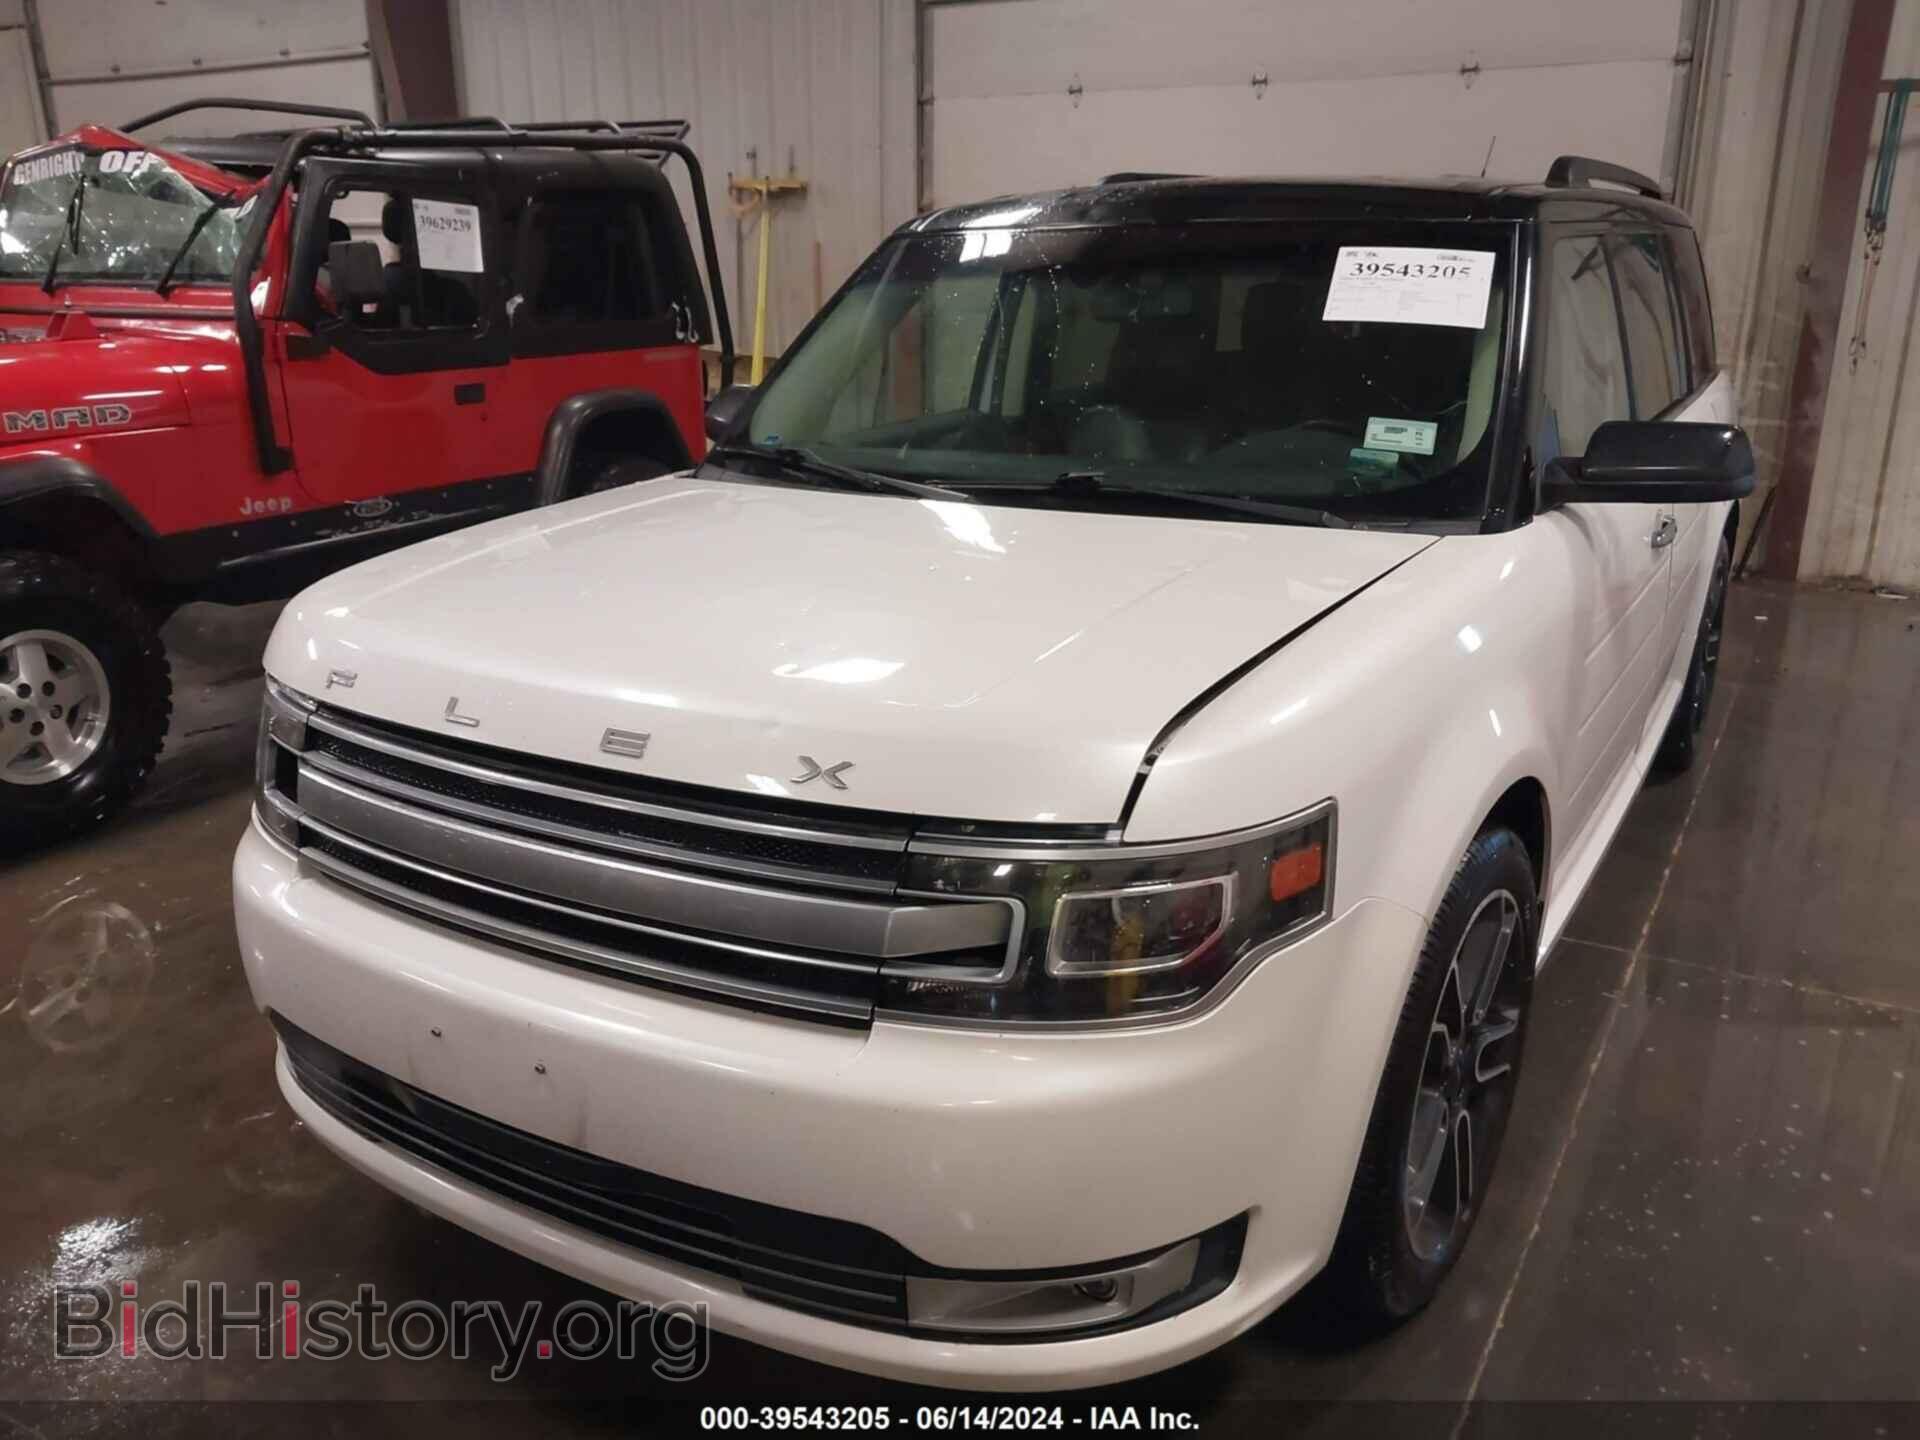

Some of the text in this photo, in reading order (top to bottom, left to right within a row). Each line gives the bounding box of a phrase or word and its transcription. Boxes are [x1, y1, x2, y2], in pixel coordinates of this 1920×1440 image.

[1349, 262, 1472, 278] 39543205
[3, 403, 132, 433] MAD
[240, 496, 293, 515] Jeep
